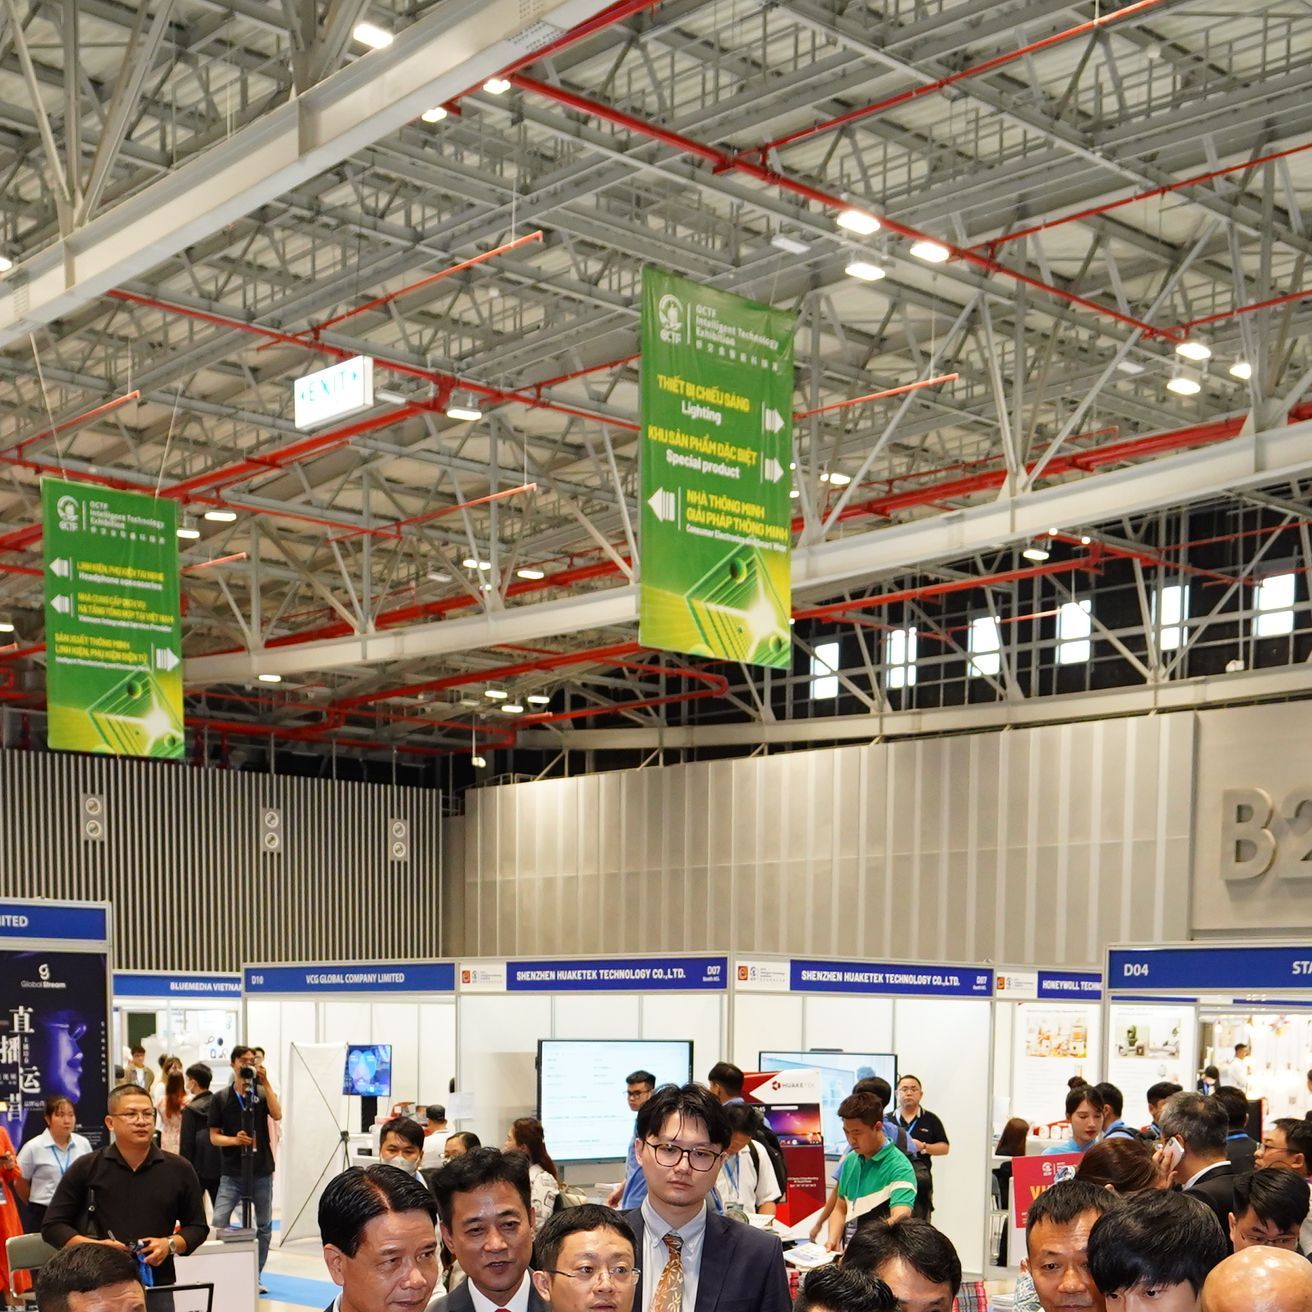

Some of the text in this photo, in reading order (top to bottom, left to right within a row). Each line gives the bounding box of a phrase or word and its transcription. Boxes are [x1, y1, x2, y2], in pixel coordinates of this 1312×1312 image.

[696, 315, 778, 351] Intelligent Technology
[681, 400, 722, 426] Lighting
[666, 448, 740, 479] Special product
[516, 967, 686, 981] SHENZHEN HUAKETEK TECHNOLOGY CO.,LTD.
[707, 965, 721, 975] D07
[1124, 963, 1149, 976] D04
[21, 980, 66, 989] Global Stream
[251, 976, 264, 985] D10
[306, 973, 405, 985] VCG GLOBAL COMPANY LIMITED
[801, 970, 843, 982] SHENZHEN
[844, 971, 884, 984] HUAKETEK
[885, 973, 932, 986] TECHNOLOGY
[170, 981, 242, 992] BLUEMEDIA VIETNA
